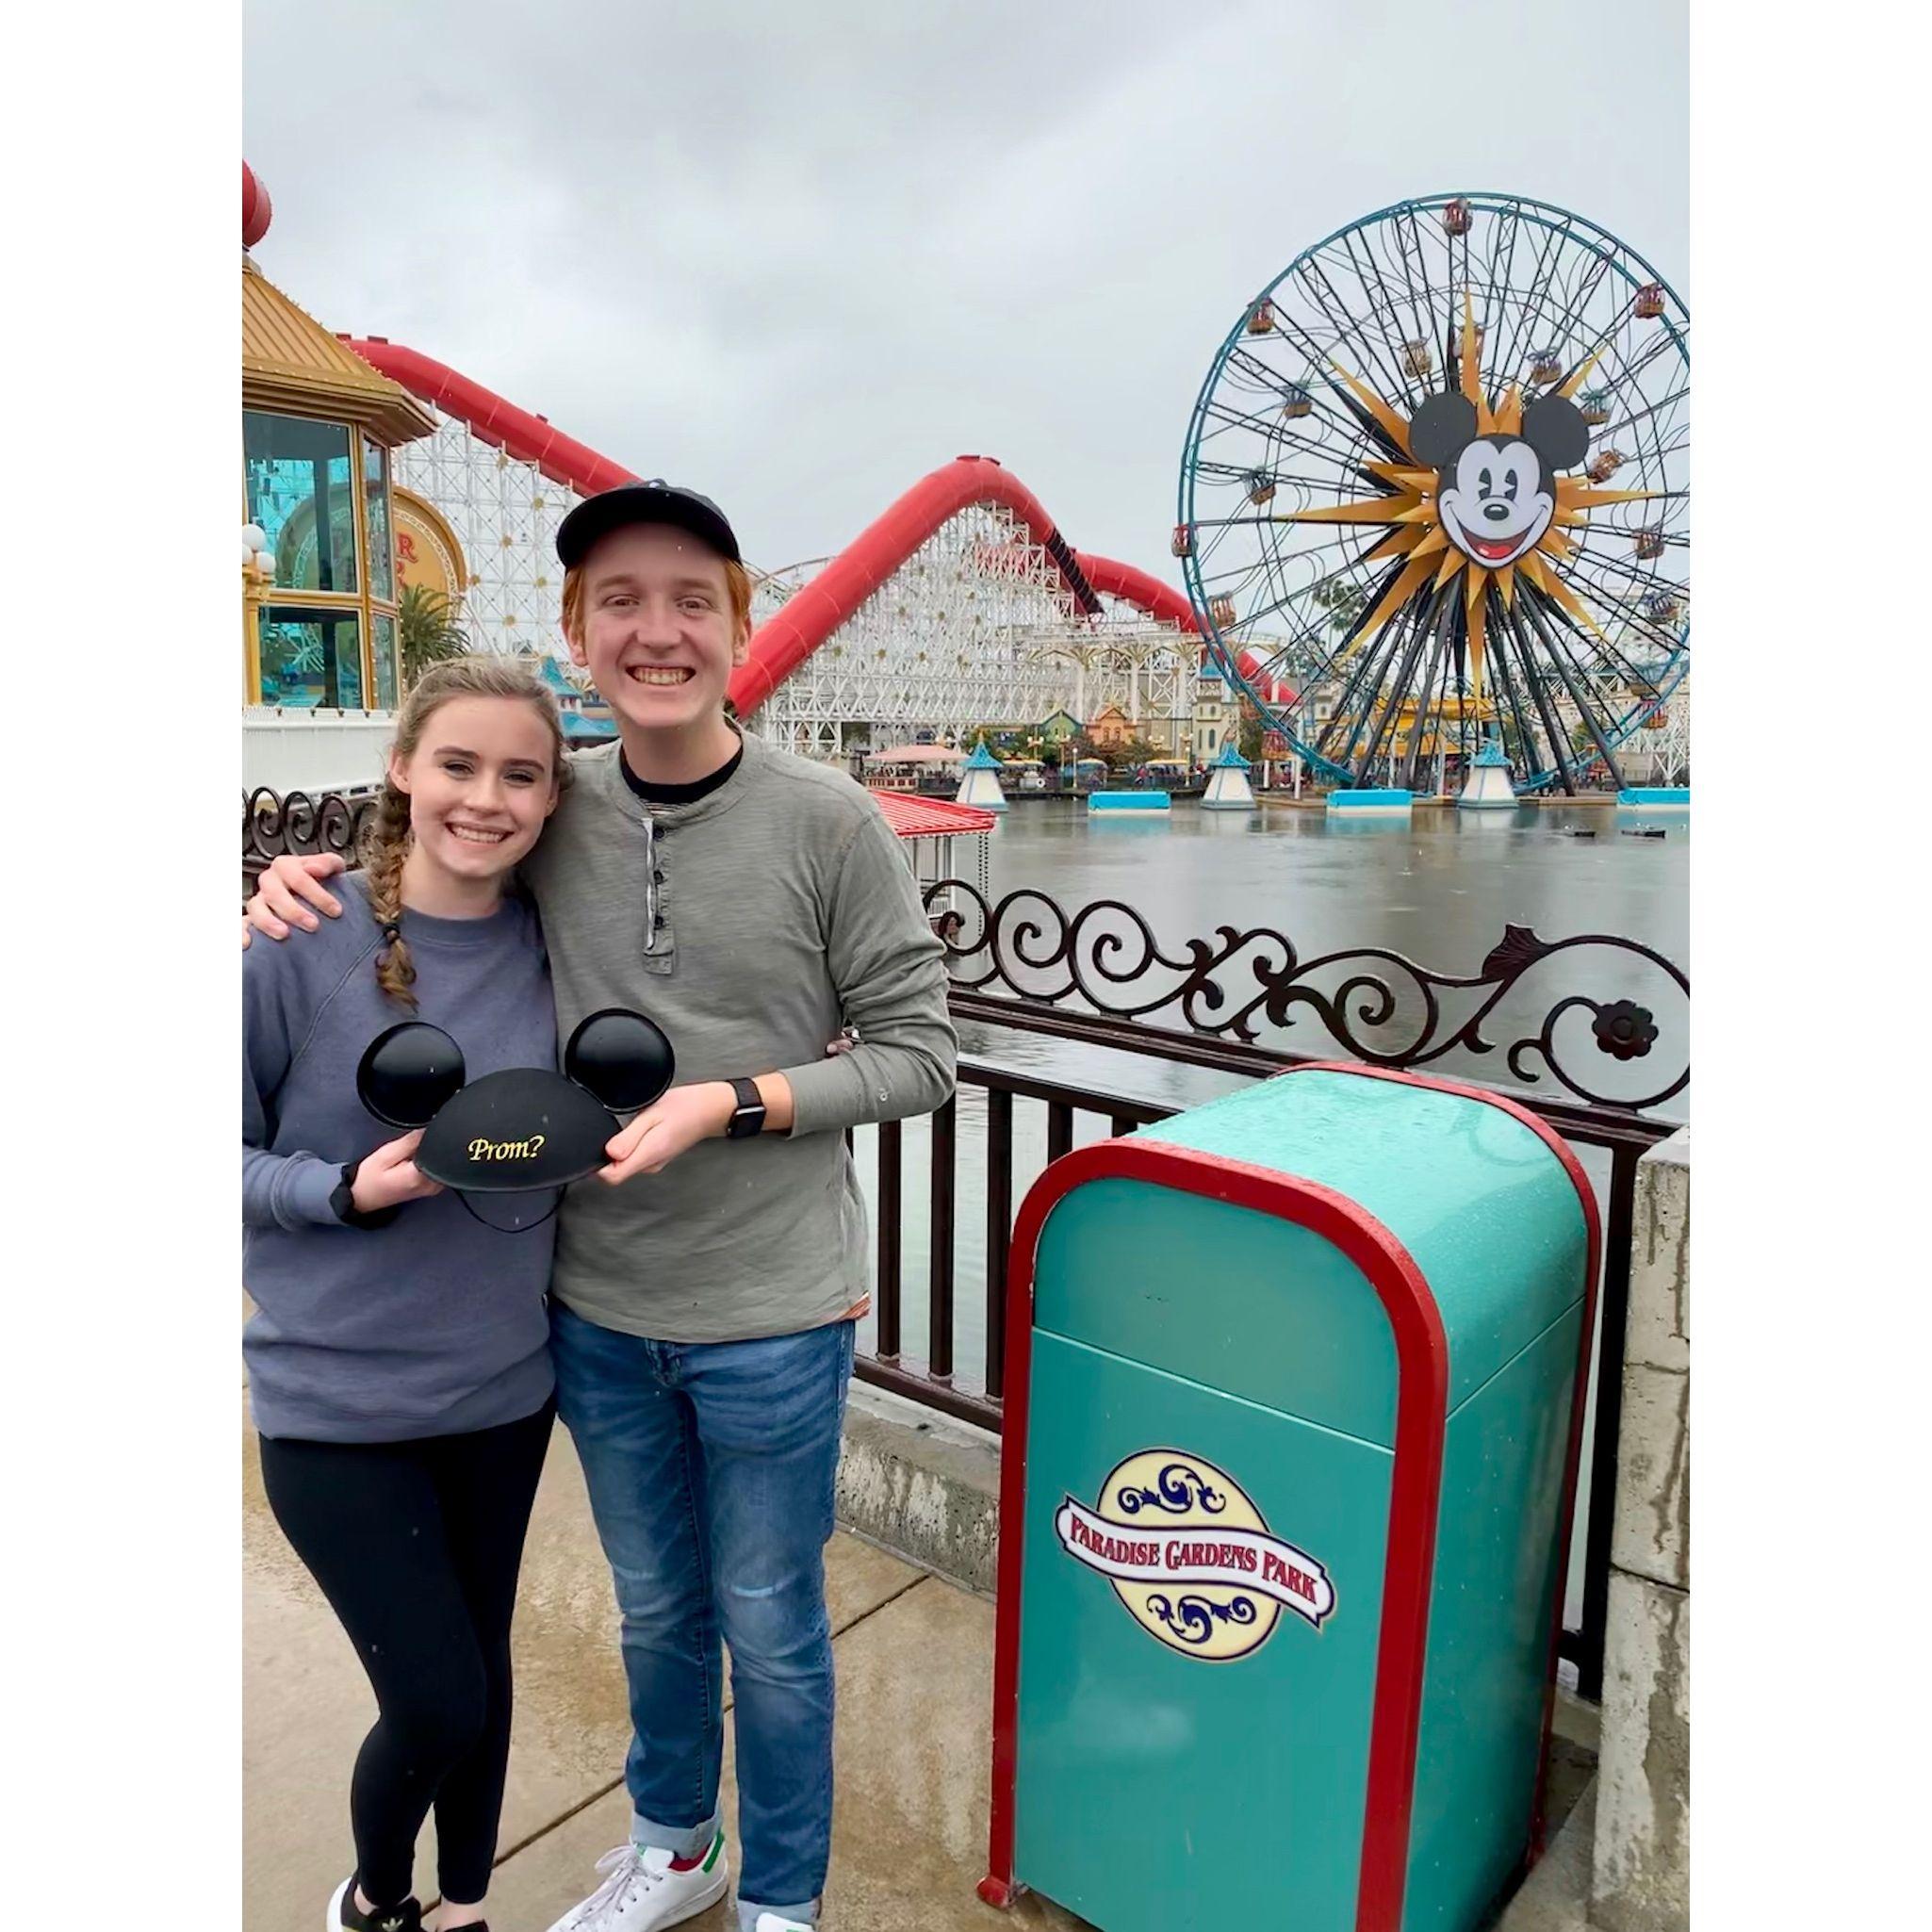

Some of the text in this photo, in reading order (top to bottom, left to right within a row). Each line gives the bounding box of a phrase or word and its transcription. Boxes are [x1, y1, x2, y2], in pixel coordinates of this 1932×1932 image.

[467, 1134, 546, 1161] Prom?
[1071, 1512, 1318, 1605] PARADISE GARDENS PARK
